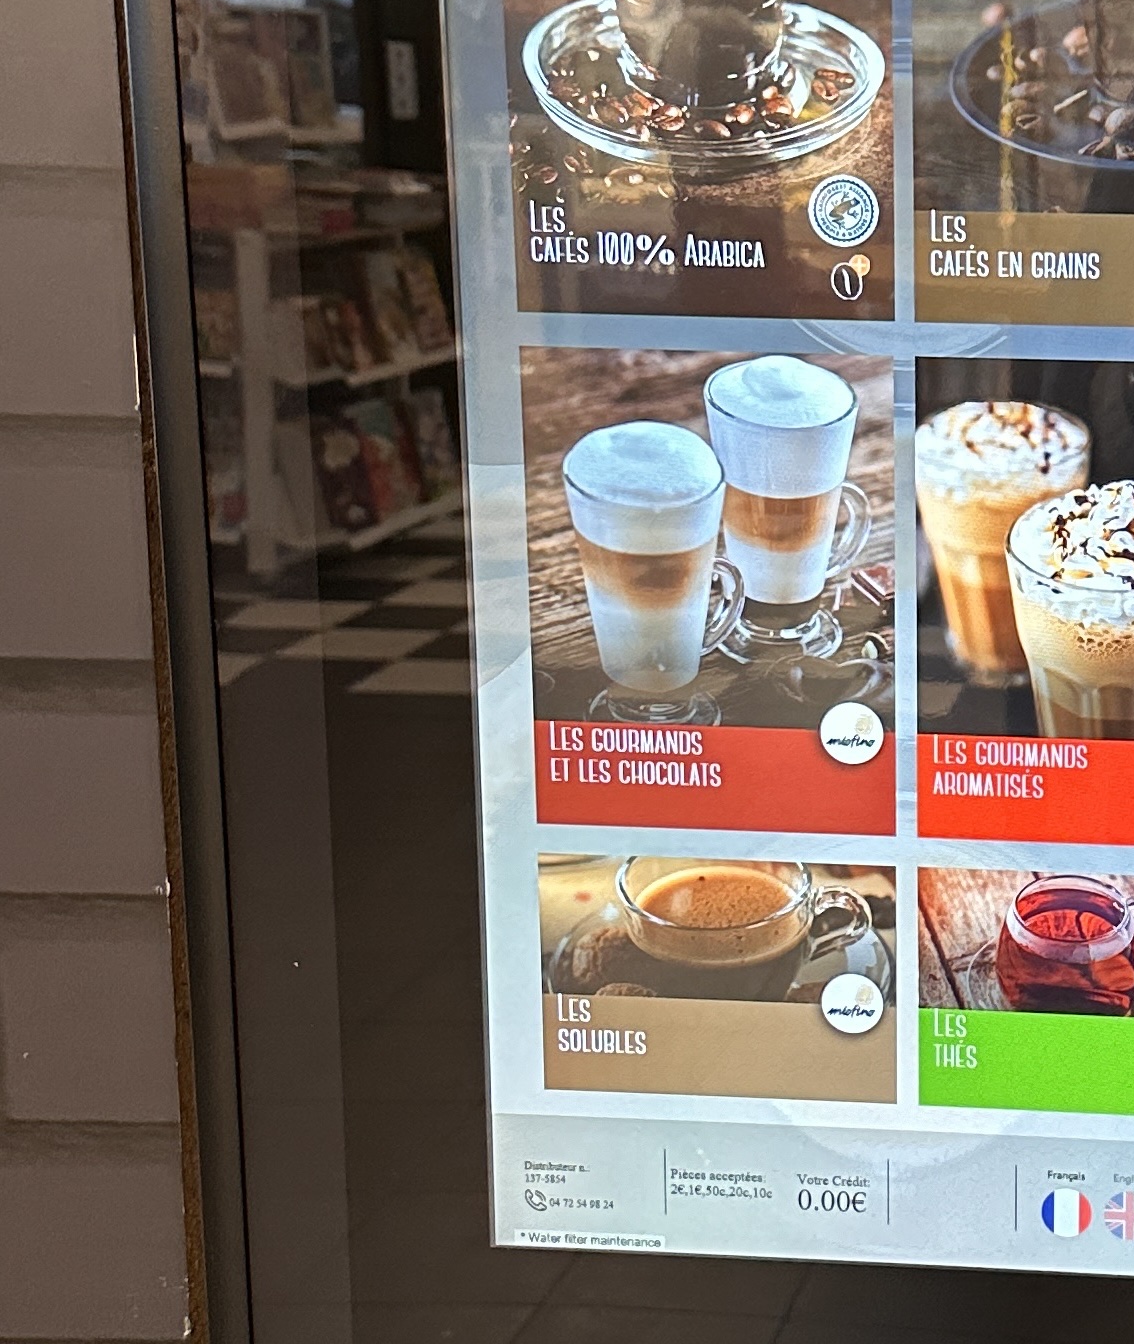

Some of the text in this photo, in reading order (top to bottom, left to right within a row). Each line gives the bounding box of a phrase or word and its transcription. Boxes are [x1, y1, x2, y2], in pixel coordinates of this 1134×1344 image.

[529, 200, 566, 234] LES
[930, 209, 967, 243] LES
[530, 230, 766, 268] CAFÉS 100% ARABICA
[930, 244, 1101, 280] CAFÉS EN GRAINS
[549, 720, 703, 756] LES GOURMANDS
[933, 734, 1088, 769] LES GOURMANDS
[550, 757, 722, 788] ET LES CHOCOLATS
[933, 767, 1045, 799] AROMATISÉS
[557, 993, 591, 1023] LES
[933, 1008, 967, 1038] LES
[558, 1028, 647, 1055] SOLUBLES
[934, 1038, 978, 1069] THÉS
[525, 1173, 566, 1184] 137-5854
[670, 1167, 706, 1181] Pièces
[796, 1173, 871, 1188] Votre Crédit:
[1047, 1170, 1086, 1183] Français
[549, 1197, 614, 1209] 04 72 54 24
[798, 1188, 867, 1213] 0.00€
[528, 1232, 662, 1248] Water filter maintenance
